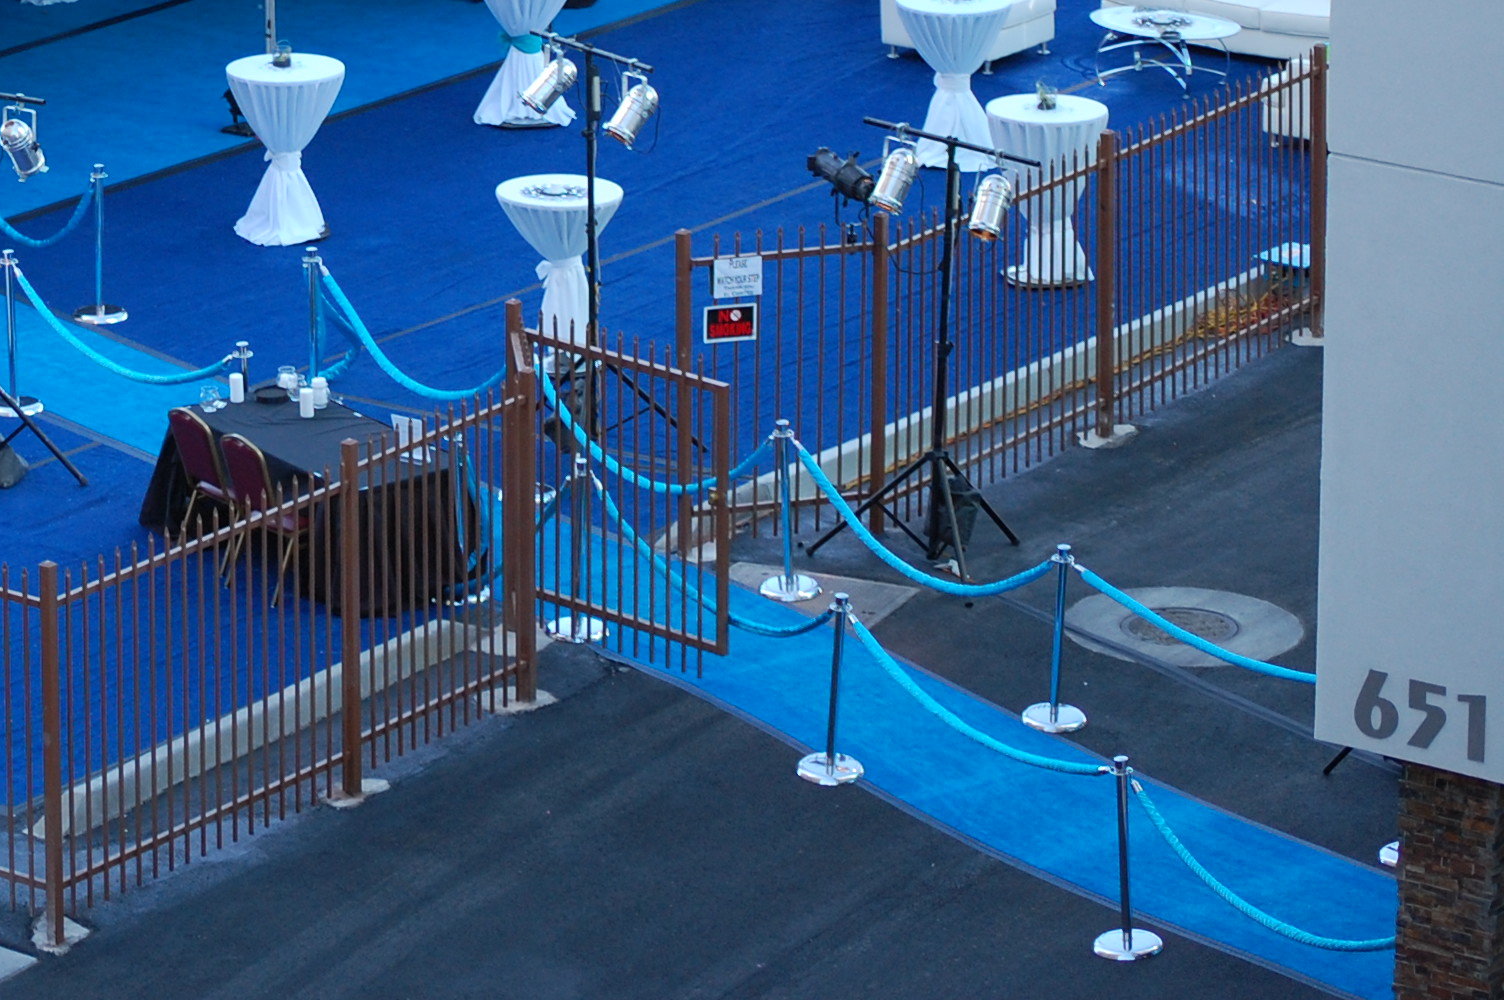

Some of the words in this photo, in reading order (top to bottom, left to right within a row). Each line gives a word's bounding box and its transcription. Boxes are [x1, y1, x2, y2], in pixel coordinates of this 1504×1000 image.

[718, 309, 742, 321] NO
[710, 322, 752, 338] SMOKING
[1354, 669, 1486, 763] 651
